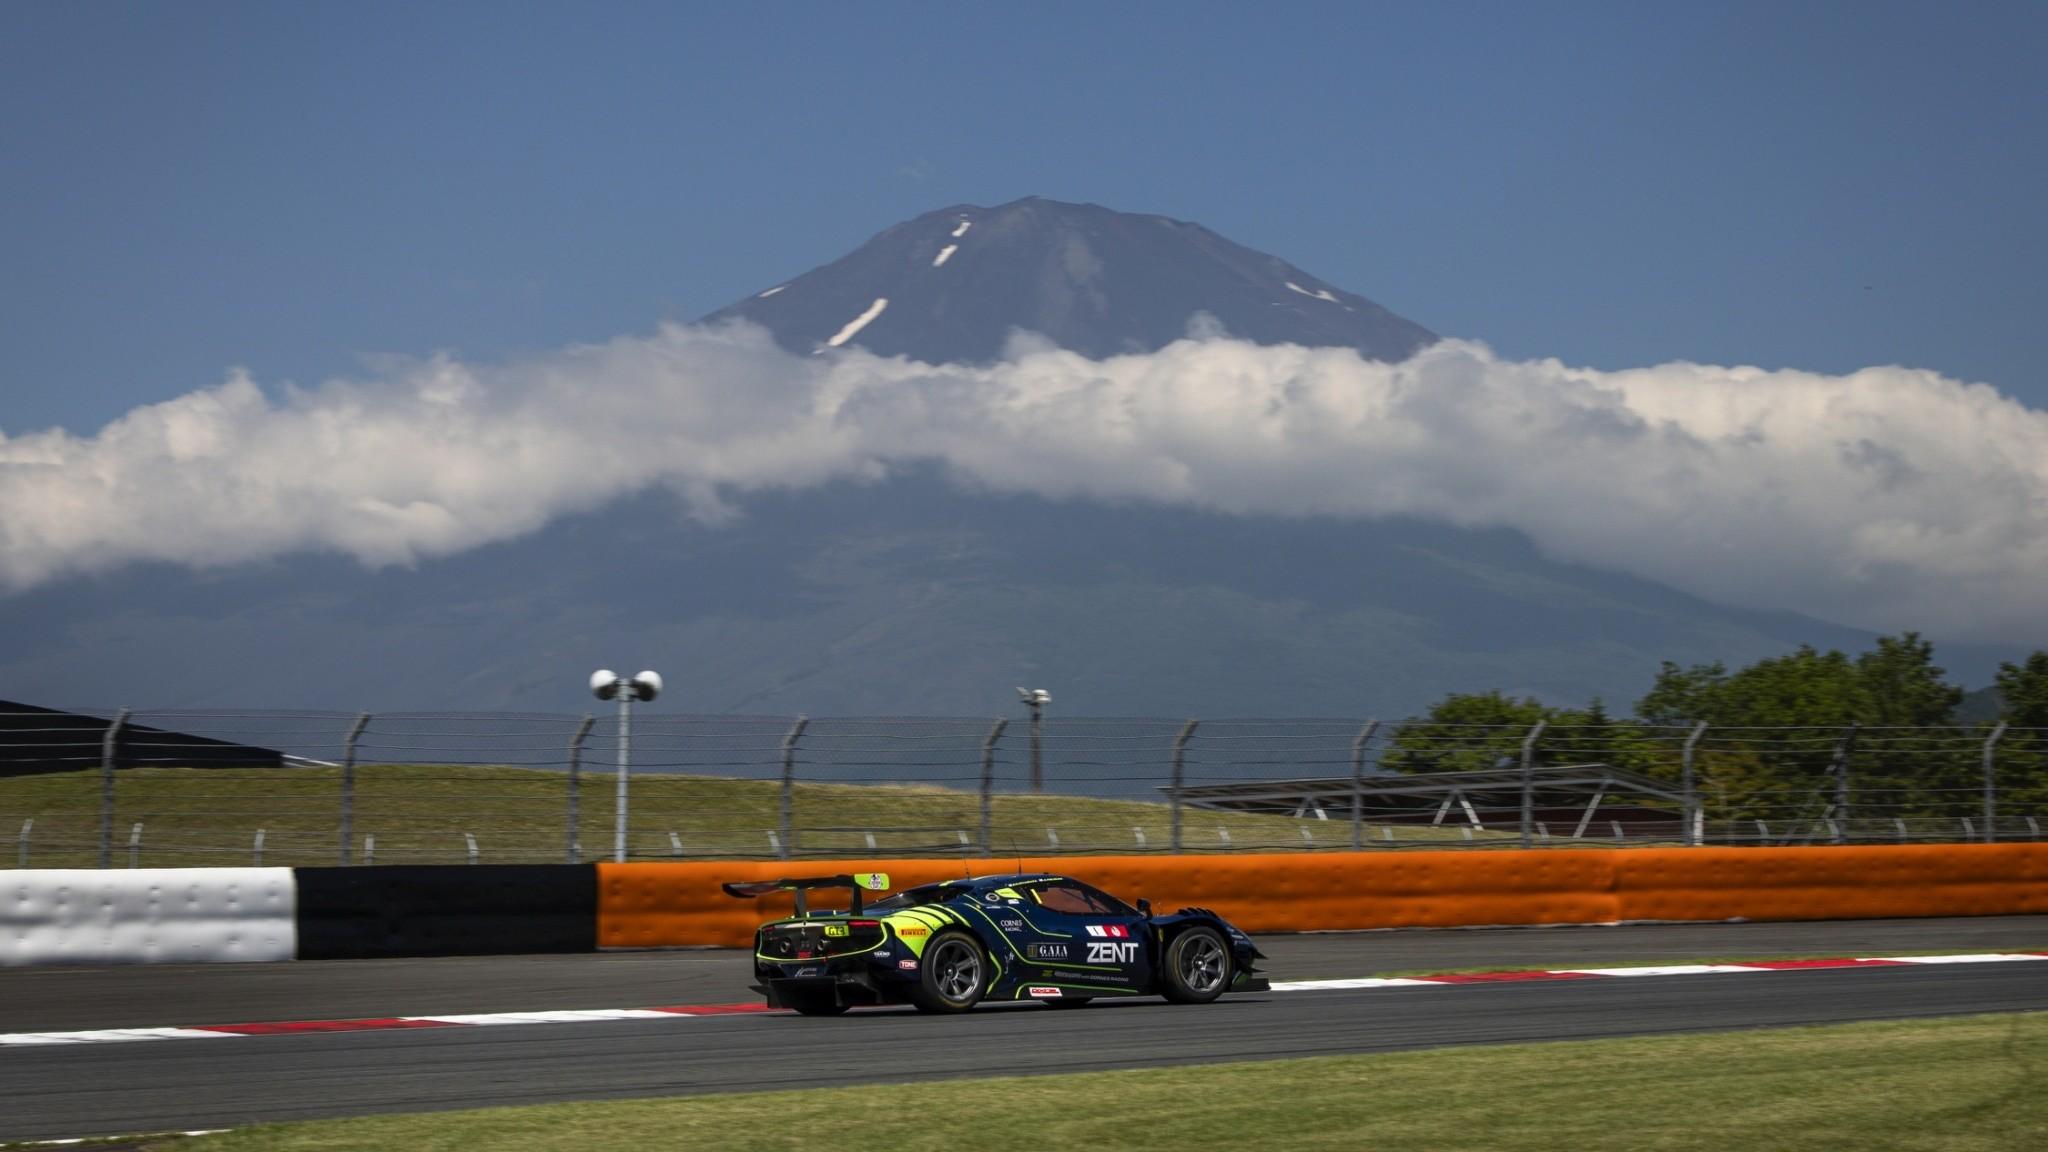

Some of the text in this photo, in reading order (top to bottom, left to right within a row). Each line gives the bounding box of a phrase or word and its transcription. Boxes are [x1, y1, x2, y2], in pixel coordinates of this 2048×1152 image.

[900, 928, 927, 936] PIRELLI
[1039, 945, 1068, 957] GAIA
[1087, 942, 1139, 963] ZENT
